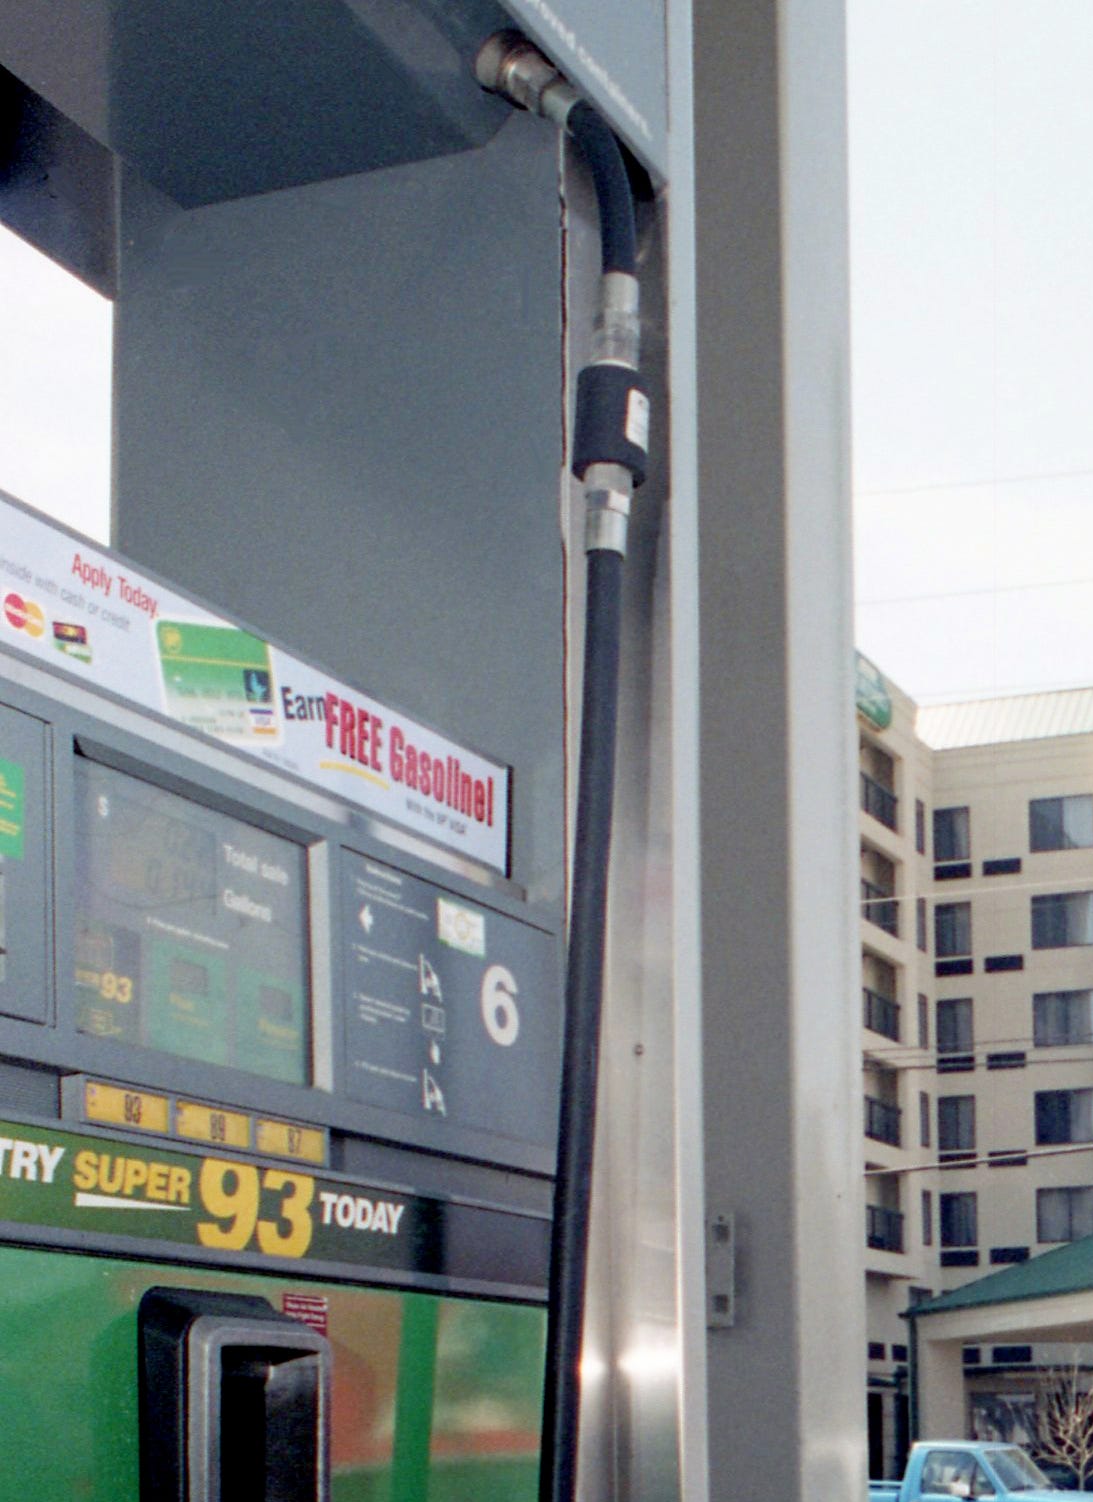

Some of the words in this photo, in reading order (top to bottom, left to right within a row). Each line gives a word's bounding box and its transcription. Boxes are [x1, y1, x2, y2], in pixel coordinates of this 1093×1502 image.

[71, 553, 113, 597] Apply
[281, 686, 326, 721] Earn
[325, 692, 383, 772] FREE
[389, 725, 494, 827] Gasoline!
[101, 972, 132, 1004] 93
[481, 965, 519, 1047] 6
[124, 1094, 142, 1124] 93
[73, 1150, 191, 1204] SUPER
[197, 1157, 315, 1258] 93
[319, 1192, 404, 1235] TODAY
